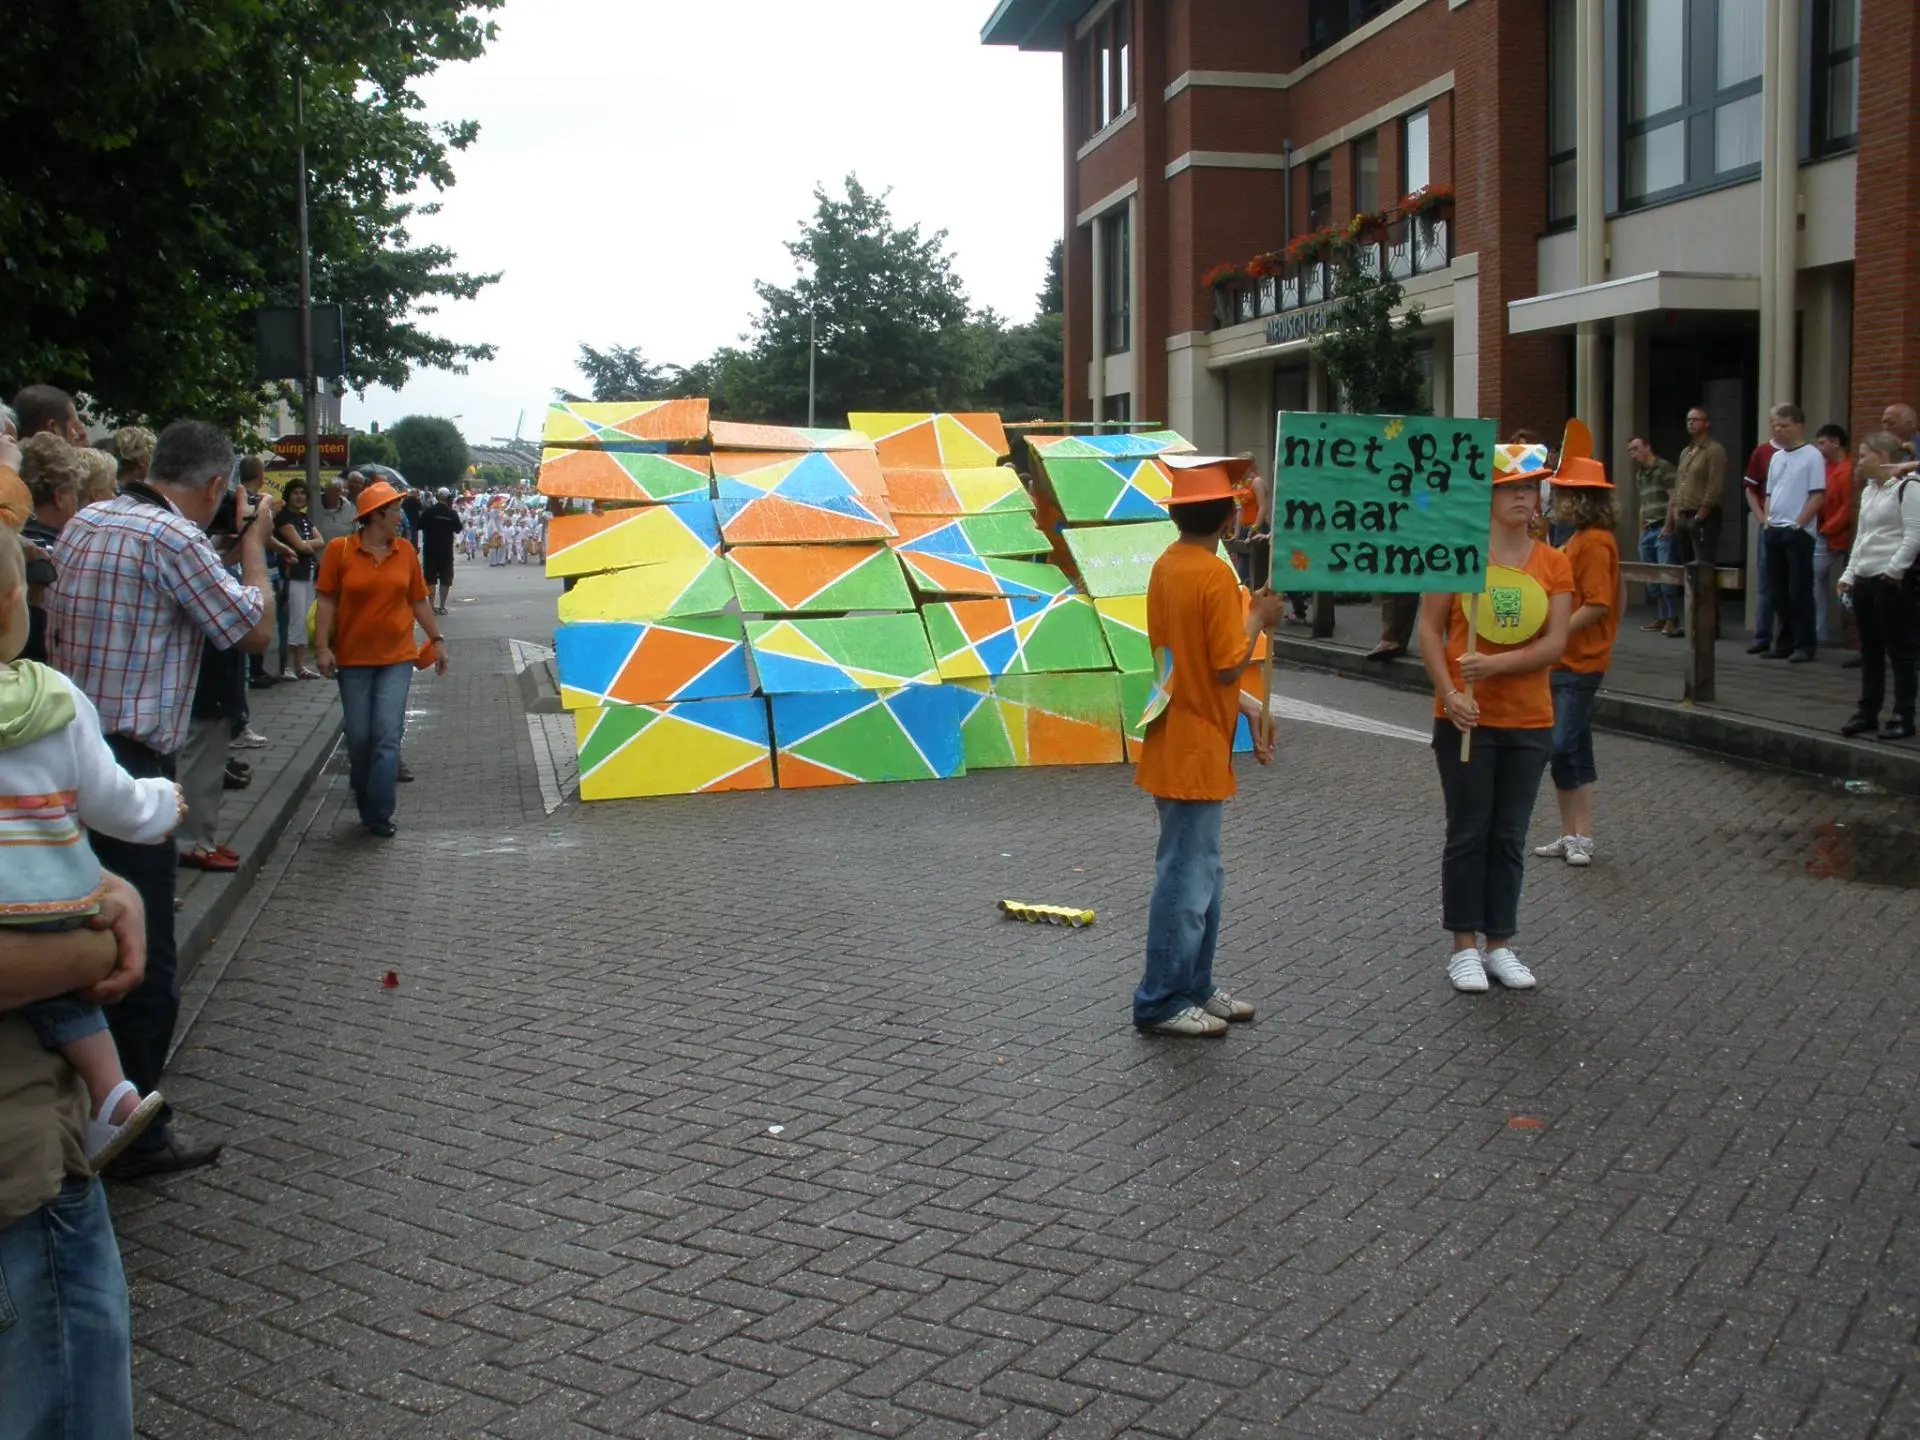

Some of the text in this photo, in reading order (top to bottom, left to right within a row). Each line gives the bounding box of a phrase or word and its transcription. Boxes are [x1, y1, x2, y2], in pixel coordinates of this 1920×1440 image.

[271, 443, 344, 455] tuinpnten
[1284, 421, 1486, 498] niet apart
[1283, 499, 1409, 533] maar
[1327, 542, 1480, 575] samen
